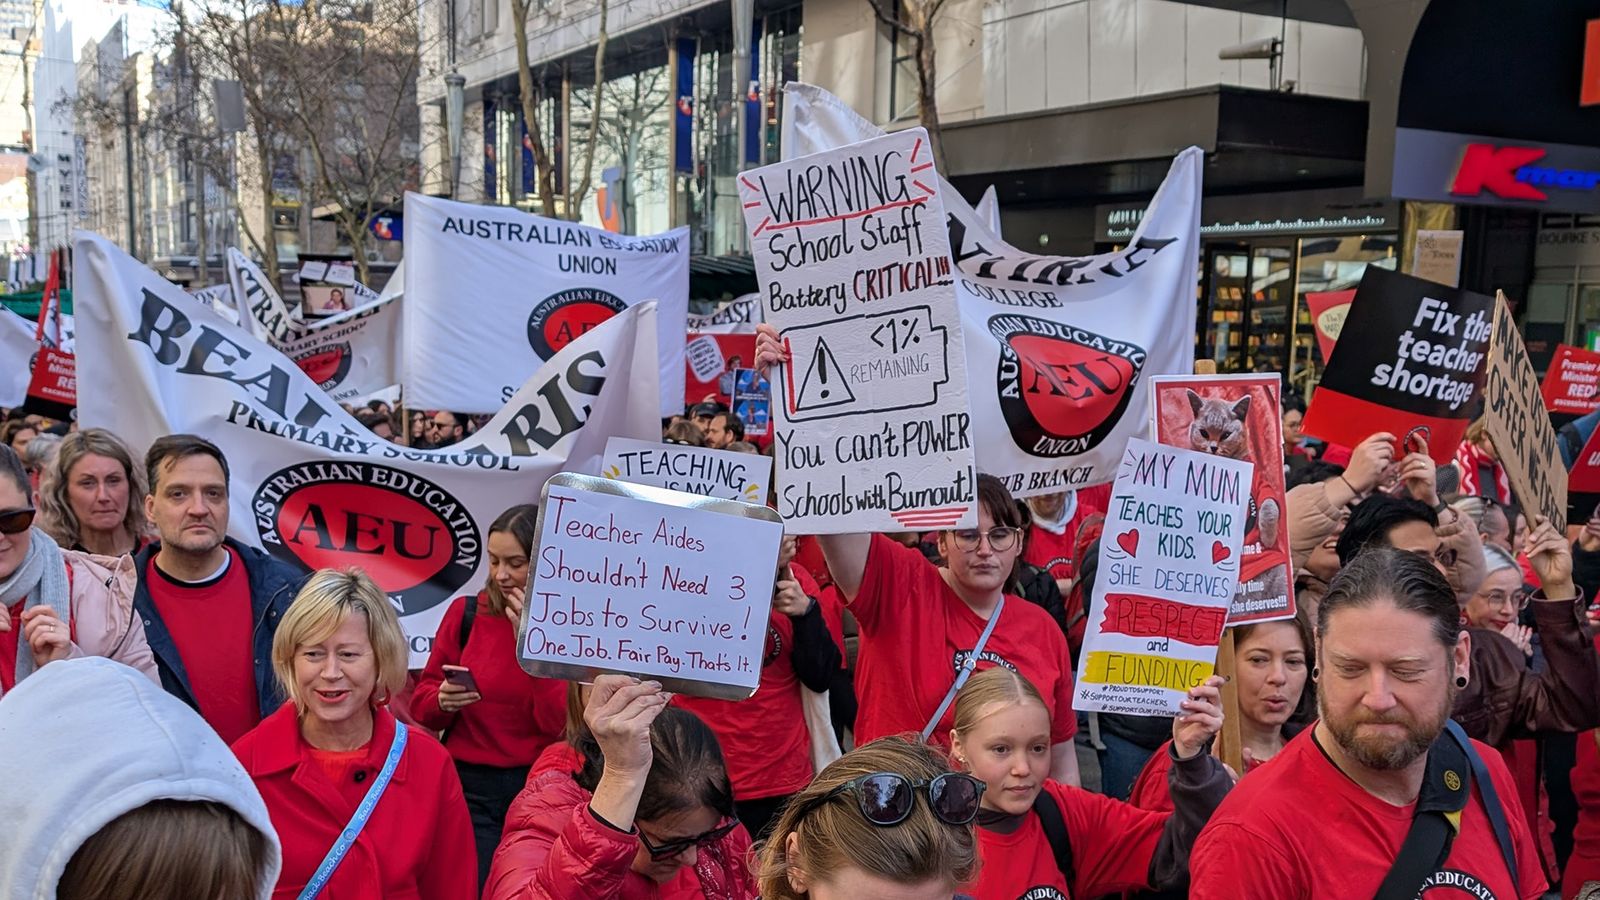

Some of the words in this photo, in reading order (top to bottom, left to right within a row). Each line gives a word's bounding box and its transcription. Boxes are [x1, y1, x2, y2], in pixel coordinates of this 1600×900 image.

[58, 154, 72, 209] MYER
[759, 151, 912, 223] WARNING
[1450, 143, 1600, 200] Kmar
[441, 217, 592, 248] AUSTRALIAN
[768, 218, 854, 271] School
[861, 202, 926, 256] Staff
[558, 254, 616, 275] UNION
[768, 281, 846, 314] Battery
[853, 256, 954, 303] CRITICAL!!!
[961, 279, 1064, 308] COLLEGE
[531, 290, 593, 331] AUSTRALIAN
[595, 291, 626, 312] EDUCA
[687, 318, 708, 328] RK
[713, 300, 754, 325] EAST
[1412, 296, 1461, 336] Fix
[1463, 310, 1492, 343] the
[552, 320, 597, 342] AE
[870, 318, 920, 354] <1%
[47, 352, 76, 366] Prem
[850, 353, 929, 384] REMAINING
[1397, 330, 1483, 373] teacher
[1561, 358, 1596, 372] Premier
[57, 377, 76, 389] RE
[1370, 359, 1475, 411] shortage
[1495, 306, 1531, 409] MAKE
[1531, 380, 1544, 438] US
[1561, 370, 1598, 383] Minister
[226, 400, 377, 456] PRIMARY
[384, 446, 519, 471] SCHOOL
[1491, 364, 1526, 469] OFFER
[776, 429, 826, 469] You
[836, 422, 899, 463] can't
[903, 413, 970, 457] POWER
[1033, 434, 1092, 454] UNION
[618, 451, 747, 493] TEACHING
[1027, 466, 1093, 490] BRANCH
[1133, 452, 1176, 489] MY
[1185, 460, 1240, 505] MUM
[256, 463, 363, 546] AUSTRALIAN
[370, 468, 477, 570] EDUCATION
[782, 475, 853, 519] Schools
[856, 485, 886, 510] with
[1115, 495, 1183, 529] TEACHES
[1197, 510, 1232, 537] YOUR
[289, 503, 441, 560] AEU
[549, 495, 643, 545] Teacher
[652, 518, 705, 551] Aides
[1157, 532, 1196, 559] KIDS.
[539, 546, 648, 588] Shouldn't
[661, 565, 709, 595] Need
[729, 576, 746, 600] 3
[1108, 563, 1142, 585] SHE
[1154, 568, 1229, 598] DESERVES
[1247, 581, 1264, 592] time
[531, 592, 594, 627] Jobs
[602, 598, 628, 628] to
[1117, 597, 1227, 640] RESPECT
[1231, 601, 1245, 613] she
[1245, 595, 1288, 611] deserves!!!
[527, 627, 567, 656] One
[571, 634, 611, 660] Job.
[618, 639, 651, 663] Fair
[657, 646, 685, 673] Pay.
[686, 651, 731, 670] That's
[737, 655, 752, 672] It.
[990, 654, 1017, 673] EDUCA
[1147, 636, 1168, 652] and
[1105, 654, 1203, 688] FUNDING
[318, 856, 339, 882] Beach
[336, 843, 346, 857] Co
[1435, 871, 1496, 900] EDUCATI
